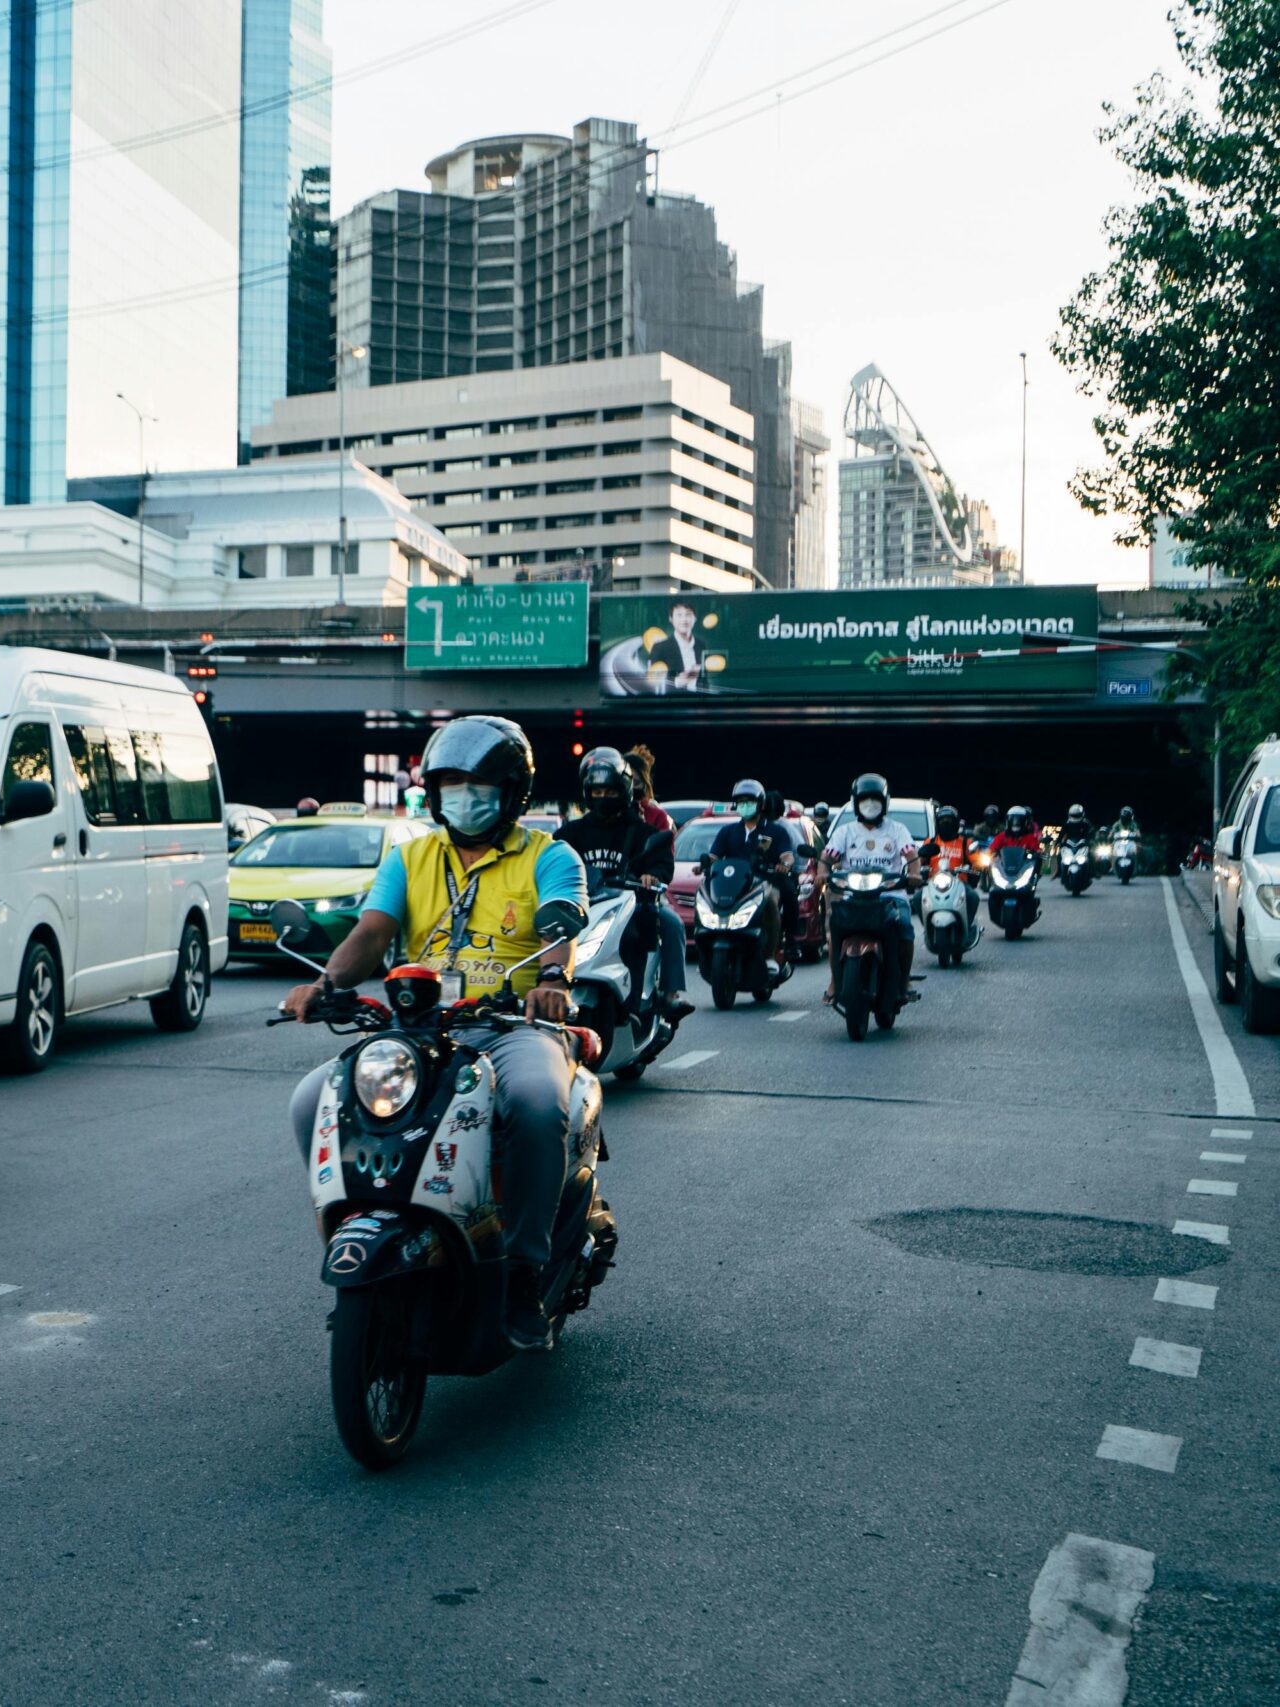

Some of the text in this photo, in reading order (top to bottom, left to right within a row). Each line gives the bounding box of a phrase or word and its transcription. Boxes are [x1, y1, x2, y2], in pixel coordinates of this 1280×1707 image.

[758, 614, 900, 643] เชื่อมทุกโอกาส
[1108, 681, 1137, 695] Plan
[468, 975, 497, 985] DAD
